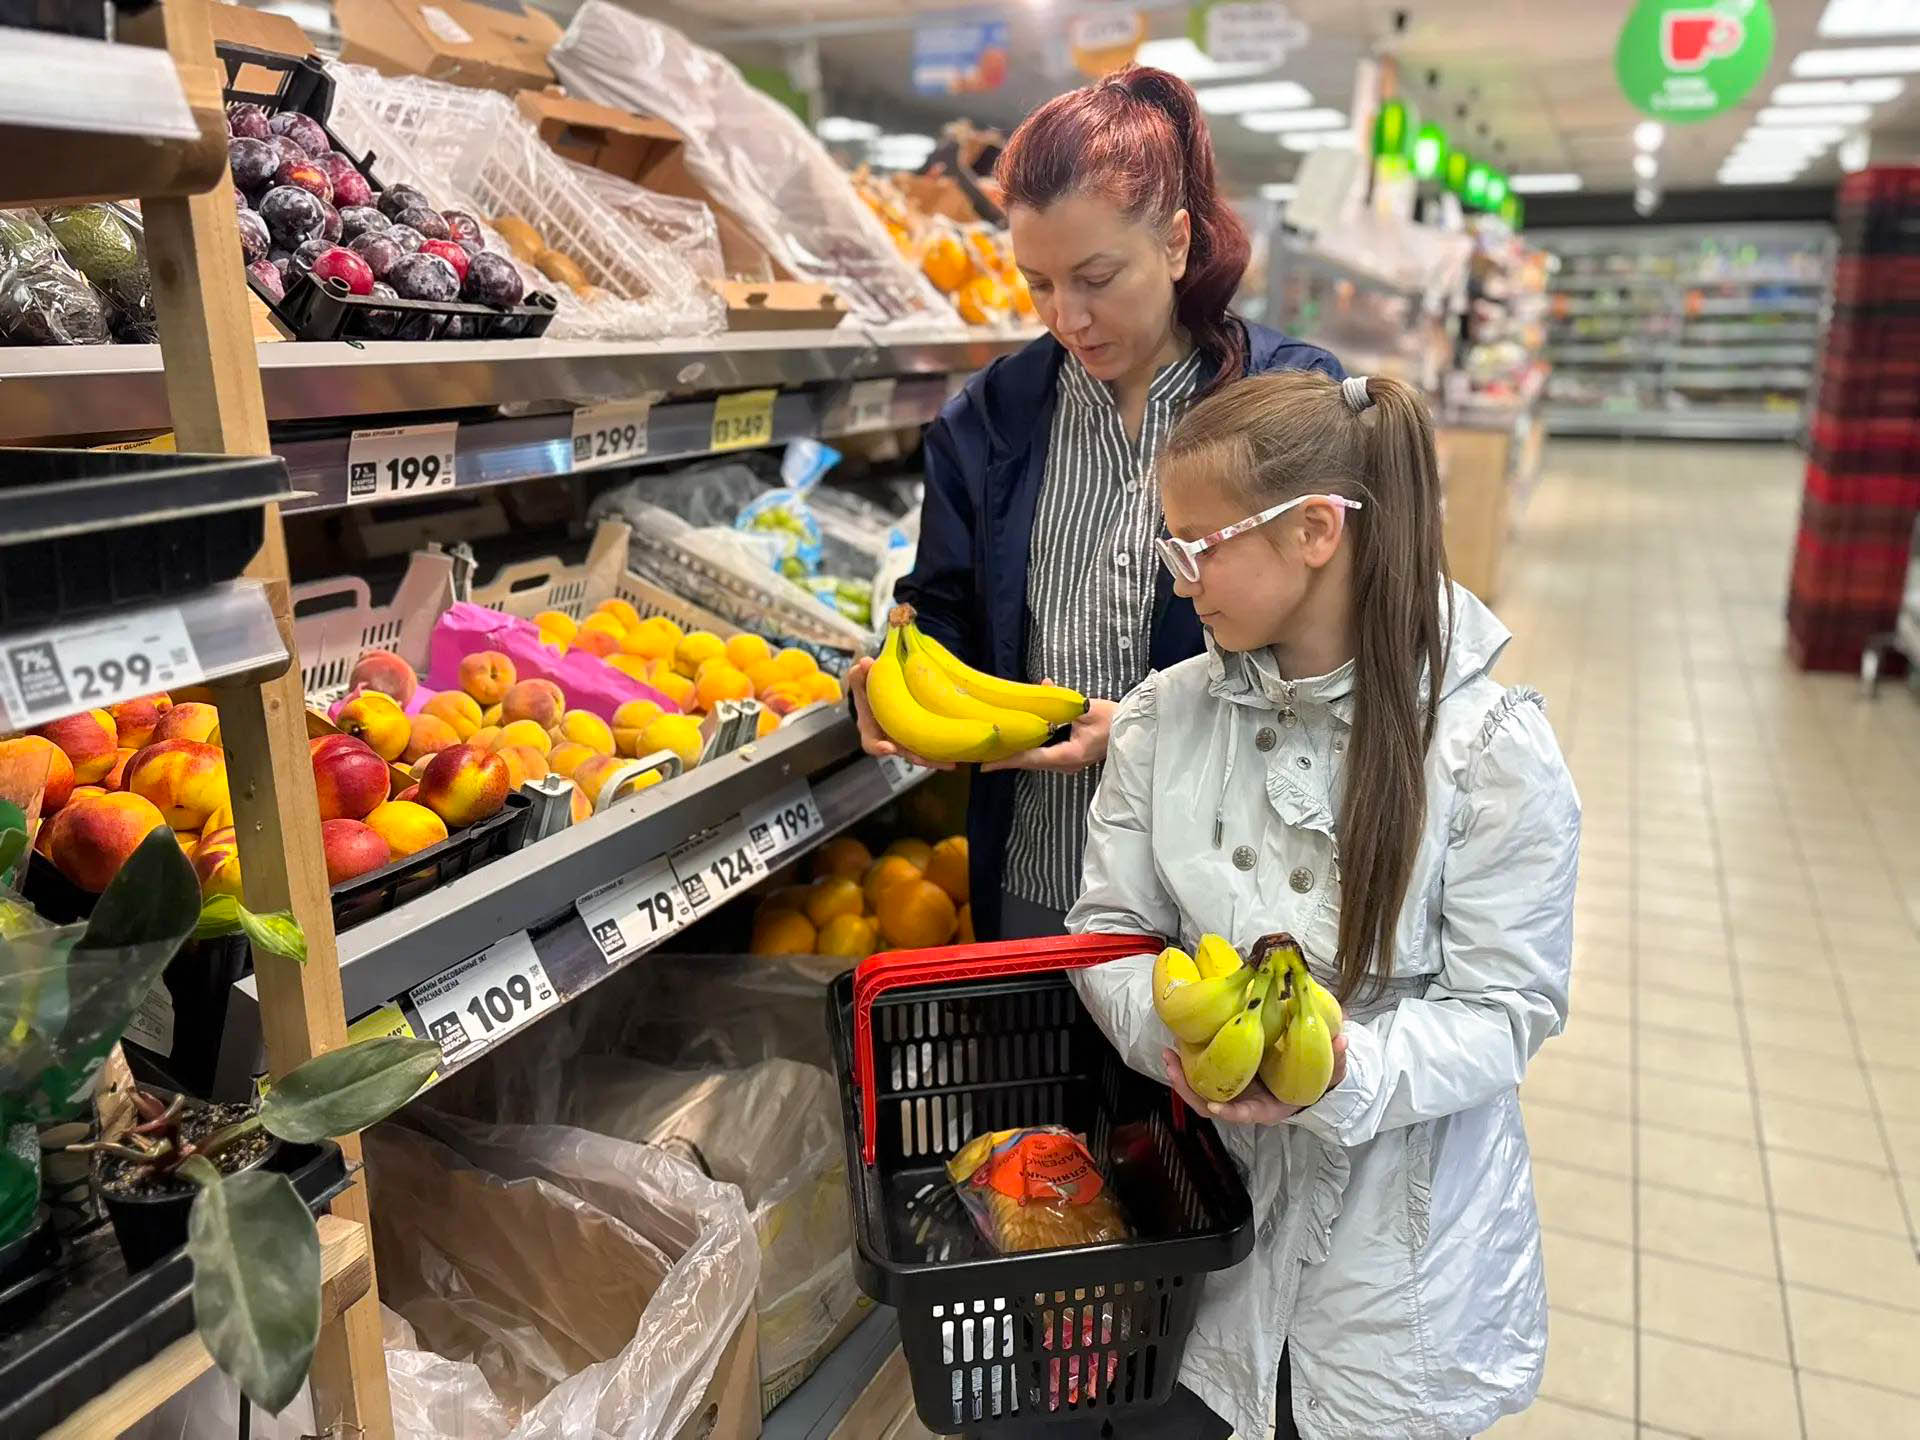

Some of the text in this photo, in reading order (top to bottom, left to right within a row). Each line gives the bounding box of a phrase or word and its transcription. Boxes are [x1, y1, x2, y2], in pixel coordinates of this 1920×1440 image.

[596, 425, 636, 456] 299
[386, 455, 440, 490] 199
[73, 653, 151, 700] 299
[775, 803, 809, 840] 199
[711, 848, 753, 890] 124
[637, 892, 674, 932] 79
[411, 980, 437, 999] БАНАНЫ
[438, 959, 478, 984] ФАСОВАННЫЕ
[417, 979, 460, 1007] КРАСНАЯ ЦЕНА
[467, 974, 532, 1033] 109
